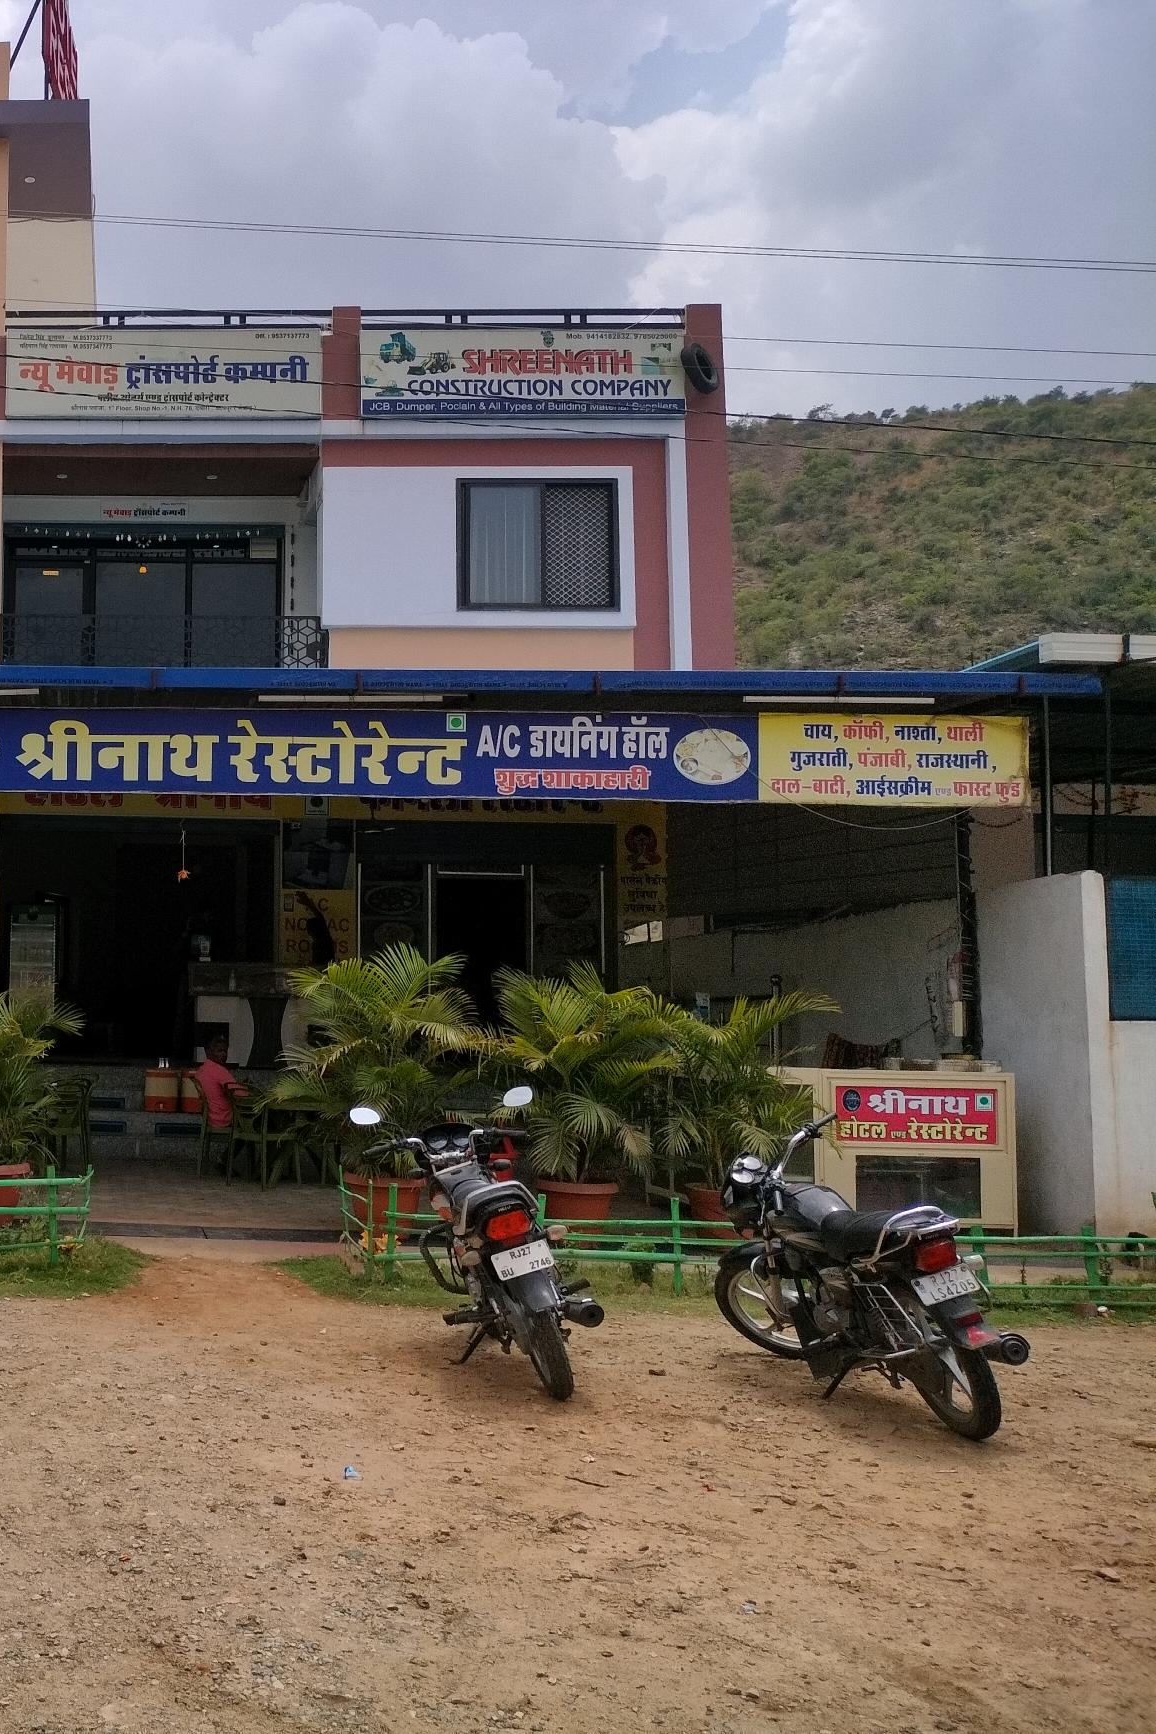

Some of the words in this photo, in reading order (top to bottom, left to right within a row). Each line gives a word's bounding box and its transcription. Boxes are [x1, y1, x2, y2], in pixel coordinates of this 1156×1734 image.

[19, 362, 55, 391] न्यू
[125, 355, 219, 390] ट्रांसपोर्ट
[223, 355, 310, 384] कम्पनी
[462, 349, 633, 376] SHREENATH
[407, 379, 563, 397] CONSTRUCTION
[571, 379, 672, 398] COMPANY
[369, 402, 393, 413] JCB,
[396, 402, 437, 414] Dumper,
[478, 402, 486, 411] &
[489, 402, 501, 411] All
[504, 402, 533, 414] Types
[535, 402, 545, 411] of
[548, 402, 586, 413] Building
[476, 724, 522, 758] A/C
[528, 714, 619, 759] डायनिंग
[621, 715, 671, 759] हॉल
[803, 723, 839, 743] चाय,
[842, 719, 890, 744] कॉफी,
[894, 725, 942, 745] नाश्ता,
[946, 720, 985, 742] थाली
[15, 719, 220, 782] श्रीनाथ
[228, 719, 468, 786] रेस्टोरेन्ट
[790, 747, 854, 772] गुजराती,
[857, 746, 912, 772] पंजाबी,
[493, 768, 542, 796] शुद्ध
[541, 764, 652, 791] शाकाहारी
[855, 774, 932, 798] आईसक्रीम
[952, 781, 993, 797] फास्ट
[994, 781, 1022, 804] फुड
[286, 939, 349, 954] ROS
[867, 1089, 970, 1116] श्रीनाथ
[839, 1115, 888, 1139] होटल
[907, 1117, 989, 1141] रेस्टोरेन्ट
[509, 1246, 532, 1260] RJ27
[529, 1257, 552, 1270] 2746
[500, 1267, 515, 1278] BU
[930, 1269, 958, 1287] RJ27
